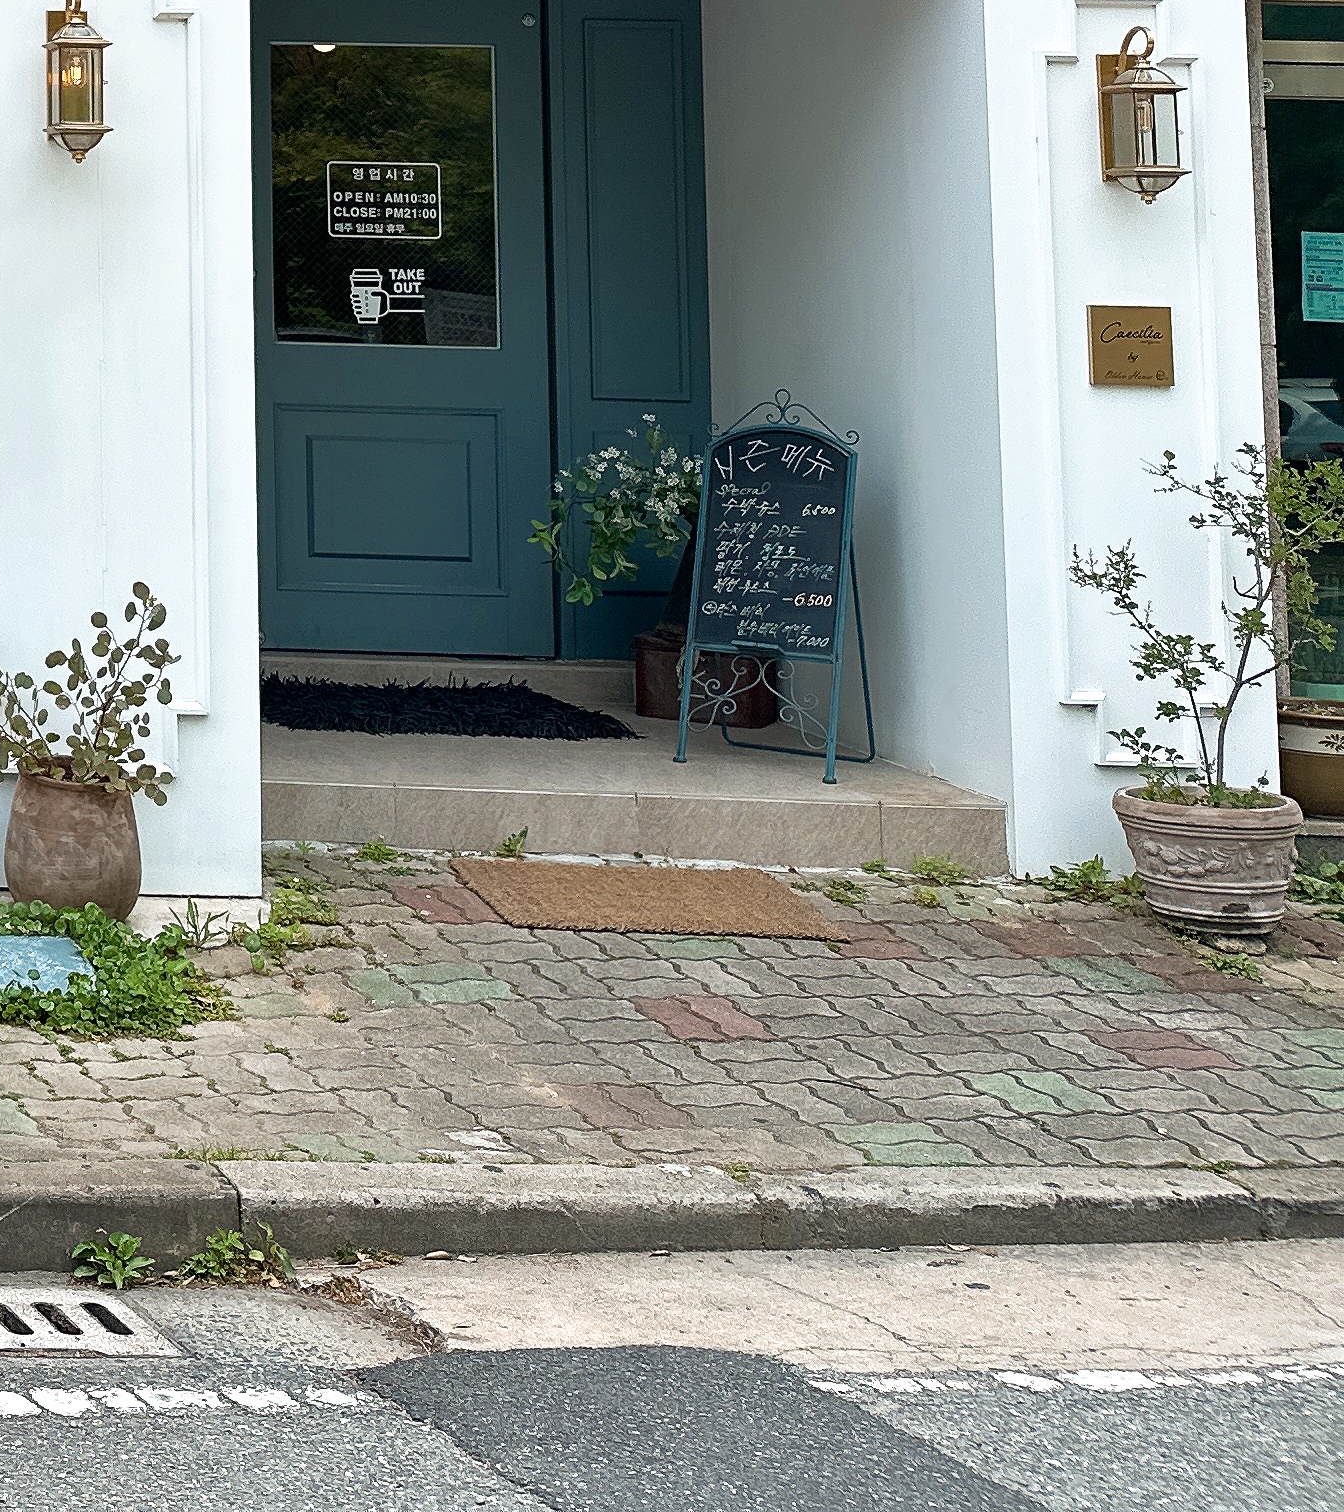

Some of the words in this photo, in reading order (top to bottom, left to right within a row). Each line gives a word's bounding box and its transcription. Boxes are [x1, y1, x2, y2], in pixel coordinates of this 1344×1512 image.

[333, 191, 381, 203] OPEN:
[384, 192, 437, 204] AM10:30
[333, 206, 381, 218] CLOSE:
[385, 208, 437, 219] PM21:00
[388, 268, 426, 280] TAKE
[393, 281, 422, 294] OUT
[1100, 321, 1164, 344] Caecilia
